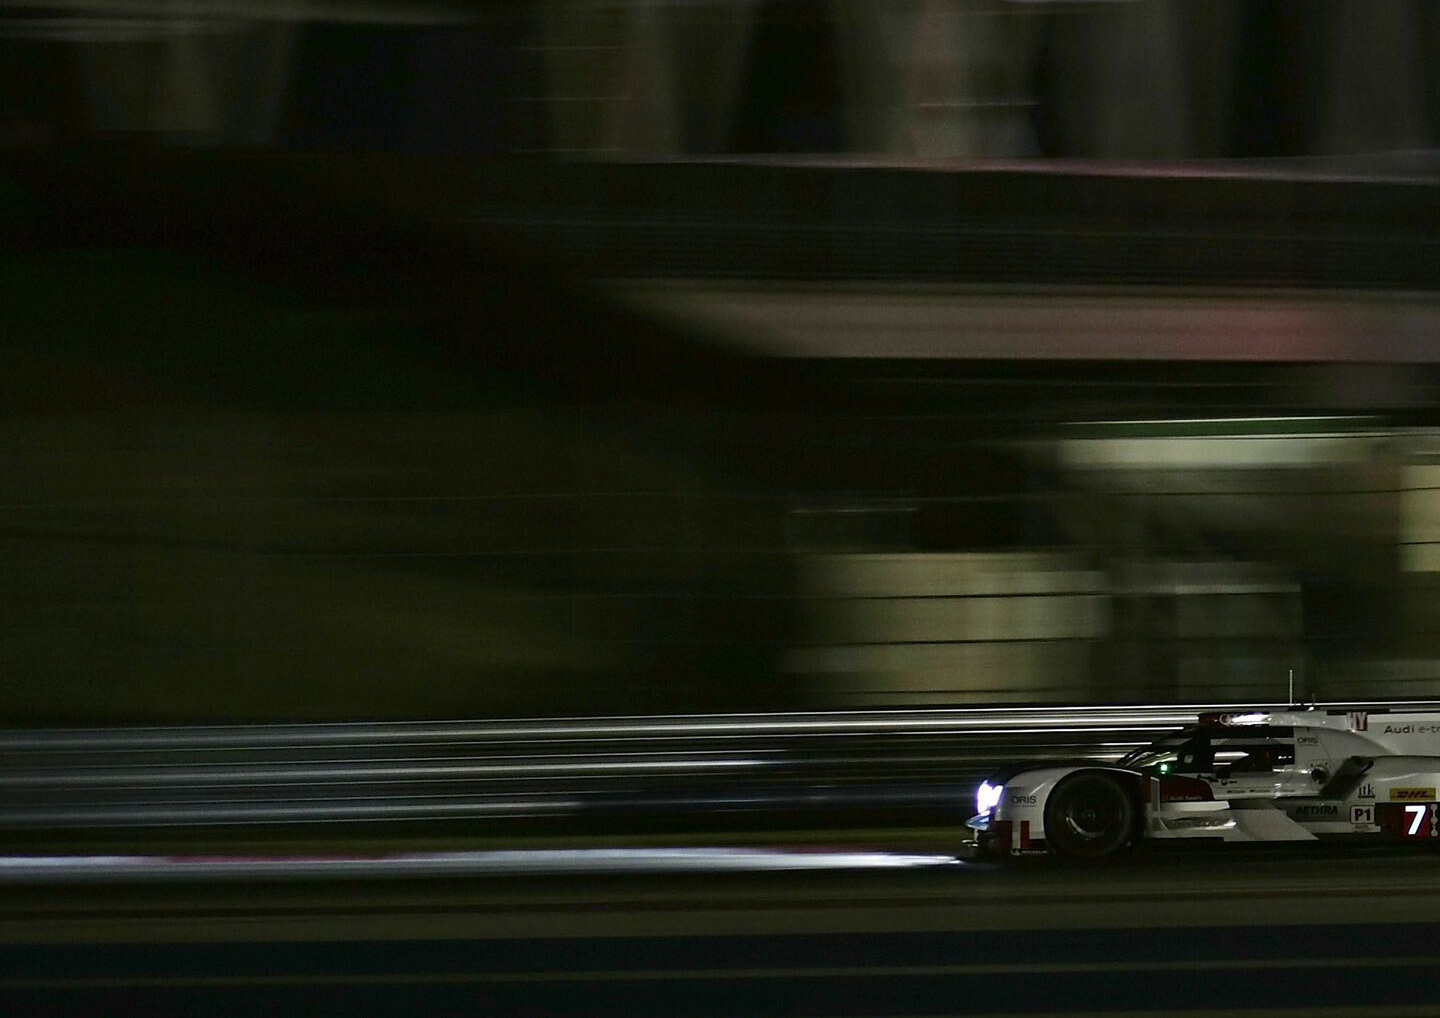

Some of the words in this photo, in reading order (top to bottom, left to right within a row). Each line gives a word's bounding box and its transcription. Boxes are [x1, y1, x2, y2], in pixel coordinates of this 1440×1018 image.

[1384, 725, 1415, 734] Audi
[1396, 790, 1429, 798] DHL
[1010, 795, 1037, 804] ORIS
[1296, 805, 1338, 815] AETHRA
[1354, 808, 1371, 821] P1
[1404, 805, 1427, 835] 7
